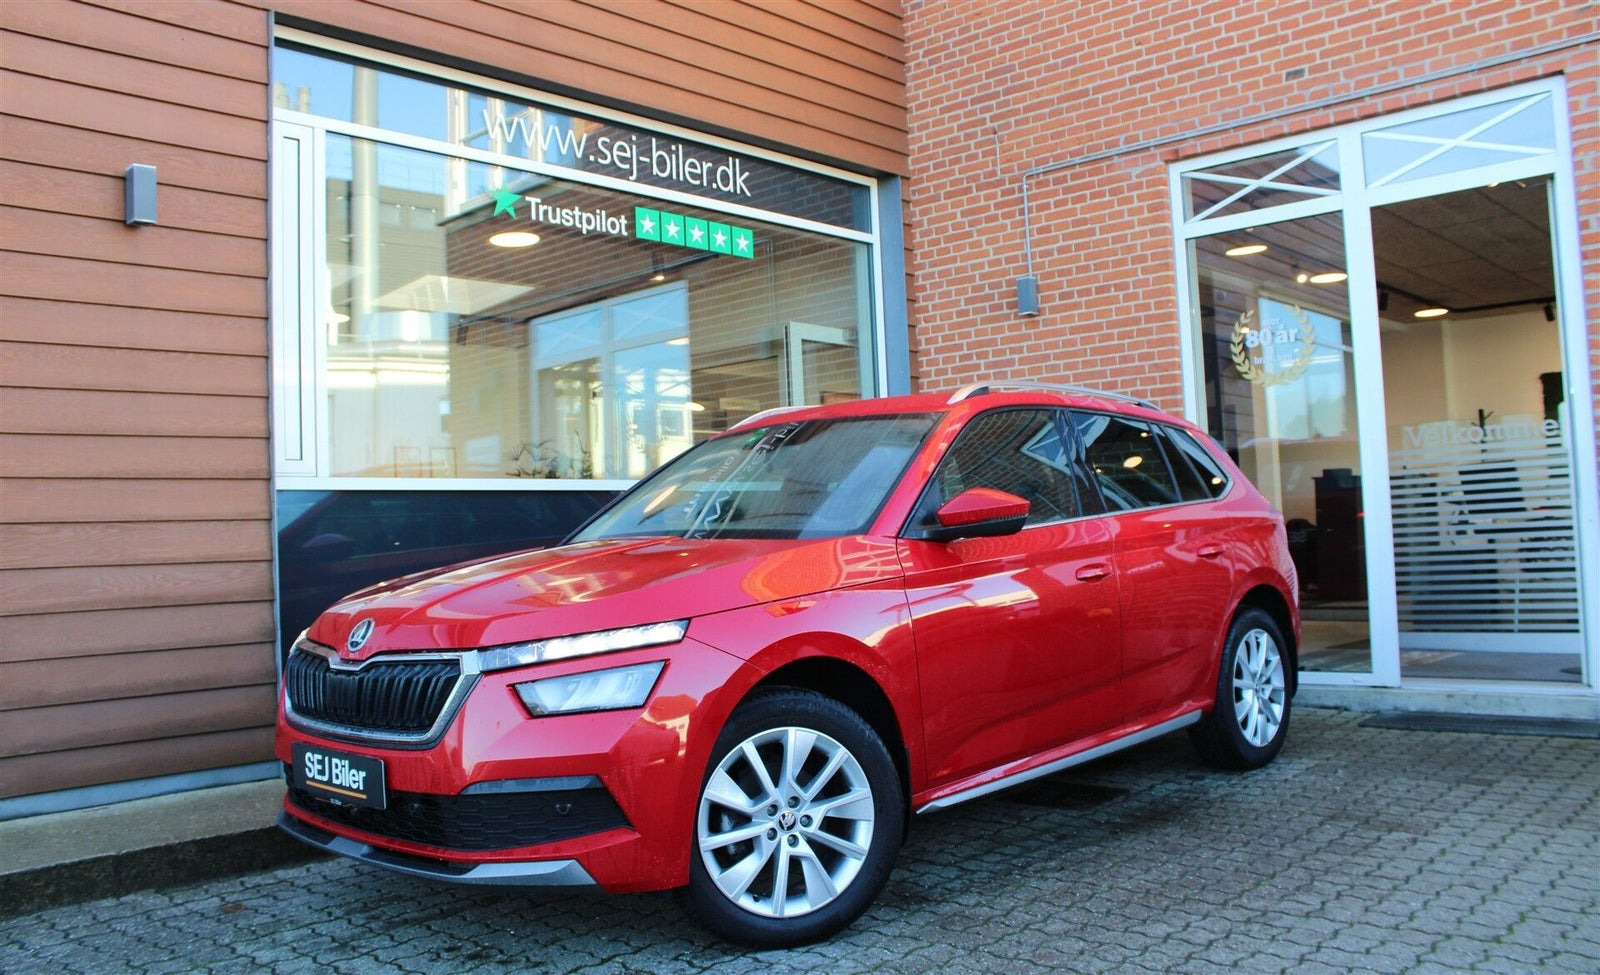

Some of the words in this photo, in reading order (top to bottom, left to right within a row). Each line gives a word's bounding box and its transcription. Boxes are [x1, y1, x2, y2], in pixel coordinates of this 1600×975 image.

[482, 109, 751, 197] www.sej-biler.dk
[525, 196, 628, 236] Trustpilot
[1245, 328, 1273, 348] 80
[304, 751, 329, 782] SEJ
[331, 757, 367, 790] Biler
